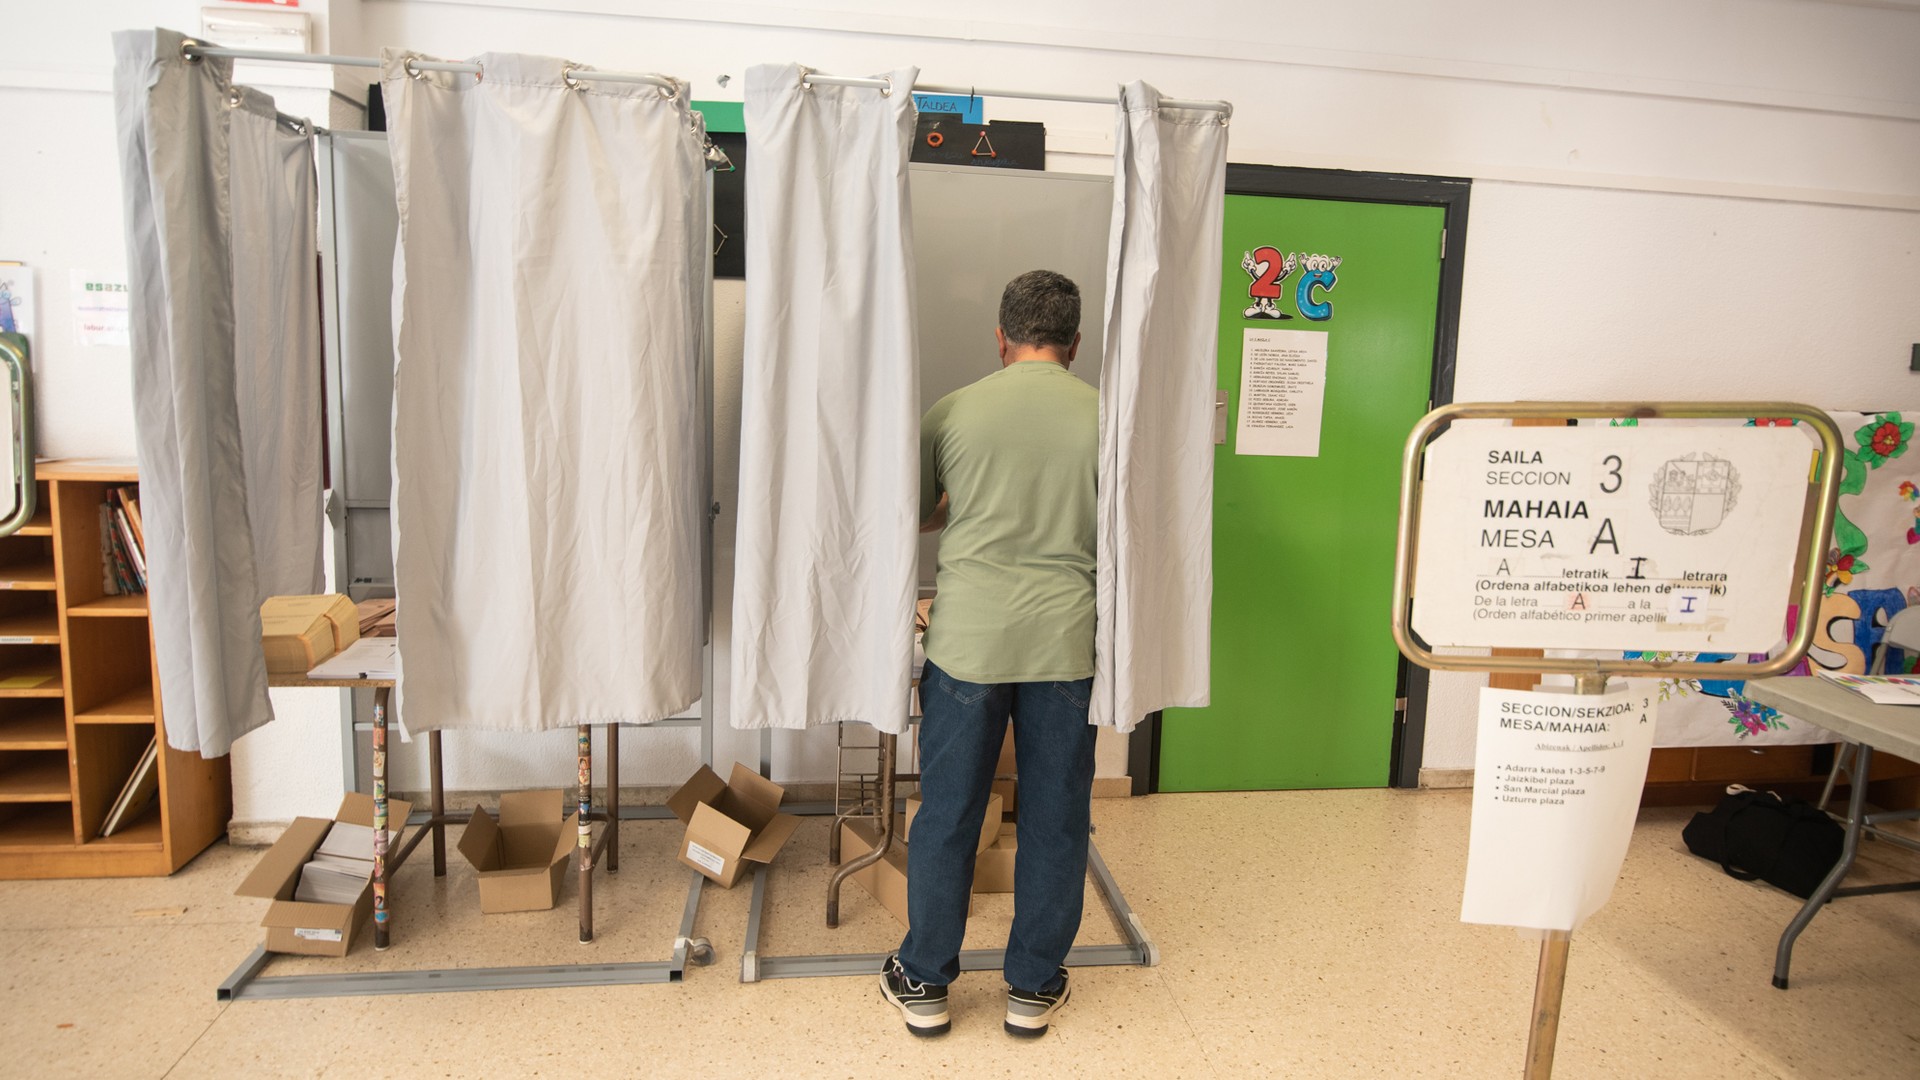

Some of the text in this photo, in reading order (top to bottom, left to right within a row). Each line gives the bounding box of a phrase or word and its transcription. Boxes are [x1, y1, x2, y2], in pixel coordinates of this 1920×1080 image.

[917, 97, 958, 112] TALDEA
[1488, 450, 1543, 464] SAILA
[1486, 471, 1571, 485] SECCION
[1600, 455, 1622, 493] 3
[1484, 499, 1589, 519] MAHAIA
[1481, 529, 1554, 548] MESA
[1589, 518, 1619, 555] A
[1496, 558, 1511, 576] A
[1562, 568, 1609, 579] letratik
[1683, 570, 1728, 582] letrara
[1475, 579, 1529, 592] (Ordena
[1533, 580, 1608, 593] alfabetikoa
[1613, 582, 1650, 593] lehen
[1474, 595, 1492, 606] De
[1495, 595, 1507, 606] la
[1510, 596, 1538, 607] letra
[1571, 593, 1586, 610] A
[1627, 600, 1636, 609] a
[1640, 598, 1651, 609] la
[1472, 608, 1517, 620] (Orden
[1520, 609, 1581, 621] alfabético
[1585, 611, 1626, 623] primer
[1501, 698, 1649, 718] SECCION/SEKZIOA: 3
[1500, 714, 1648, 733] MESA/MAHAIA: A
[1505, 764, 1537, 773] Adarra
[1541, 766, 1566, 775] kalea
[1504, 775, 1575, 785] Jaizkibel plaza
[1503, 785, 1585, 796] San Marcial plaza
[1502, 794, 1565, 806] Uzturre plaza
